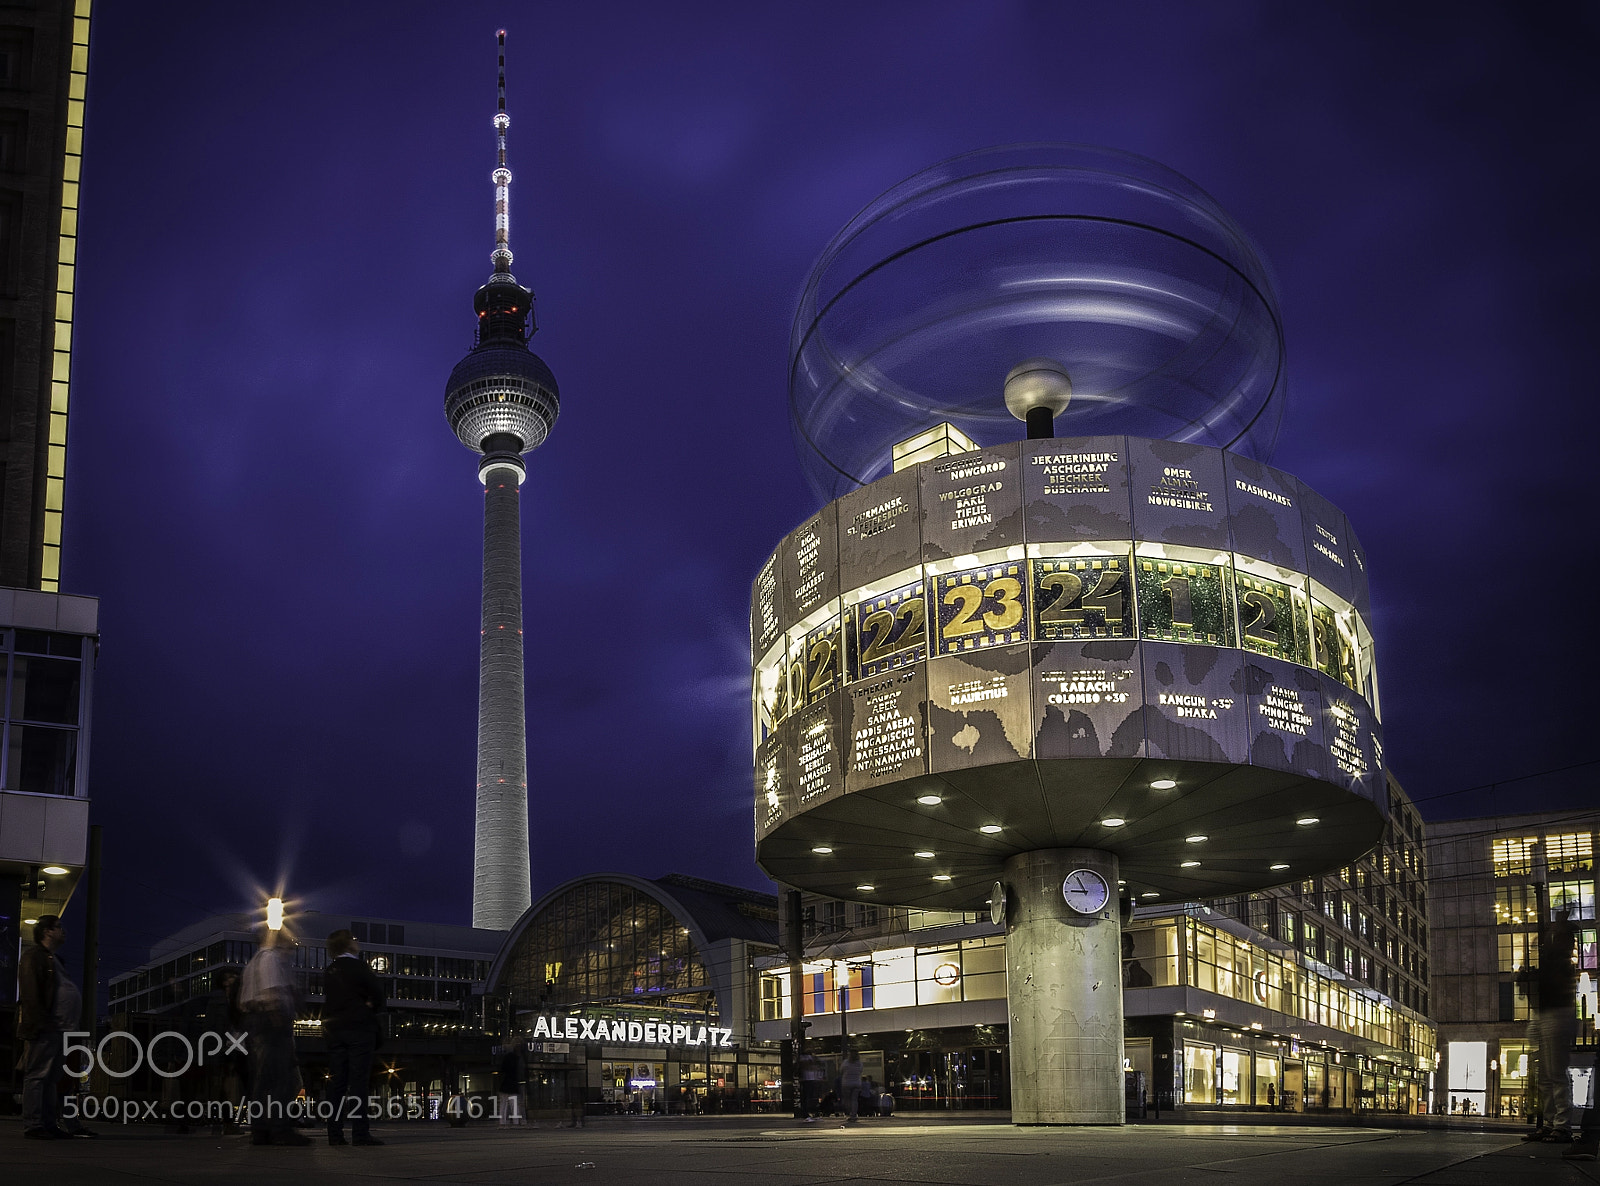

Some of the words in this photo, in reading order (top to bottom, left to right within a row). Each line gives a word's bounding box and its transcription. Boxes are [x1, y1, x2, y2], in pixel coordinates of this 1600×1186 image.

[1031, 453, 1118, 465] JEKATERINBURG
[1043, 463, 1109, 475] ASCHGABAT
[950, 461, 1006, 481] NOWGOROD
[1049, 473, 1102, 484] BISCHKEK
[1163, 467, 1192, 479] OMSK
[939, 481, 1003, 502] WOLGOGRAD
[1235, 479, 1292, 508] KRASNOJARSK
[955, 504, 987, 519] TIFLIS
[956, 495, 985, 509] BAKU
[1147, 495, 1214, 512] NOWOSIBIRSK
[951, 513, 992, 530] ERIWAN
[796, 536, 821, 560] TALLINN
[1040, 571, 1124, 624] 24
[1162, 576, 1194, 627] 1
[942, 577, 1024, 639] 23
[1244, 590, 1280, 645] 2
[861, 598, 926, 665] 22
[950, 687, 1008, 706] MAURITIUS
[1060, 682, 1115, 693] KARACHI
[1271, 685, 1298, 700] HANOI
[1048, 693, 1101, 704] COLOMBO
[1159, 694, 1206, 707] RANGUN
[1266, 694, 1304, 714] BANGKOK
[867, 709, 901, 726] SANAA
[1177, 706, 1218, 720] DHAKA
[1259, 704, 1289, 721] PHNOM
[1291, 712, 1313, 727] PENH
[856, 725, 882, 741] ADDIS
[885, 715, 915, 732] ABEBA
[1268, 717, 1306, 736] JAKARTA
[801, 742, 813, 755] TEL
[813, 733, 828, 750] AVIV
[855, 726, 915, 751] MOGADISCHU
[798, 742, 832, 767] JERUSALEM
[855, 737, 916, 762] DARESSALAM
[852, 747, 921, 773] ANTANANARIVO
[799, 762, 832, 787] DAMASKUS
[533, 1016, 733, 1047] ALEXANDERPLATZ
